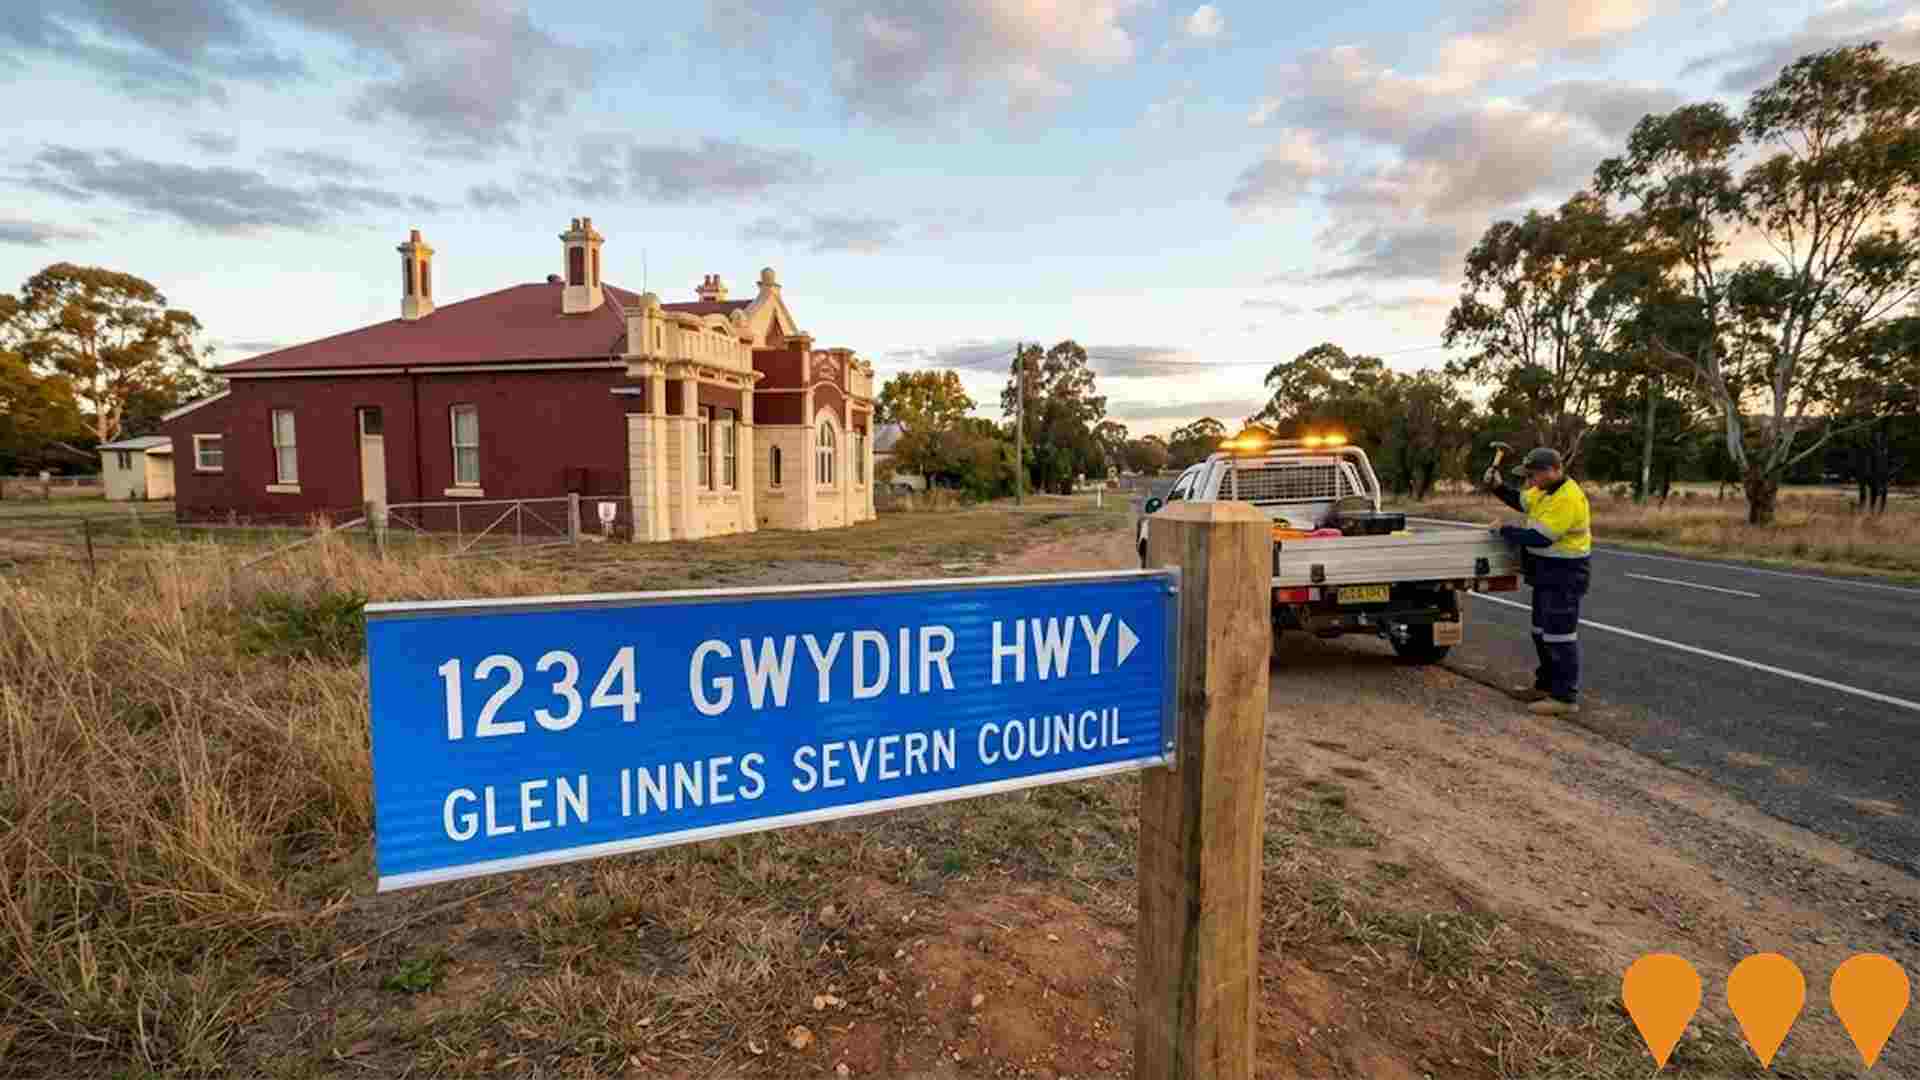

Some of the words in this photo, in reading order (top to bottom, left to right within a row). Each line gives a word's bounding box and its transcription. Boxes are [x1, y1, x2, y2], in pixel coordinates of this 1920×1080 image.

[438, 647, 641, 740] 1234
[689, 625, 956, 716] GWYDIR
[991, 613, 1112, 685] HWY
[443, 774, 590, 842] GLEN
[621, 752, 766, 817] INNES
[792, 728, 957, 792] SEVERN
[978, 707, 1129, 764] COUNCIL
